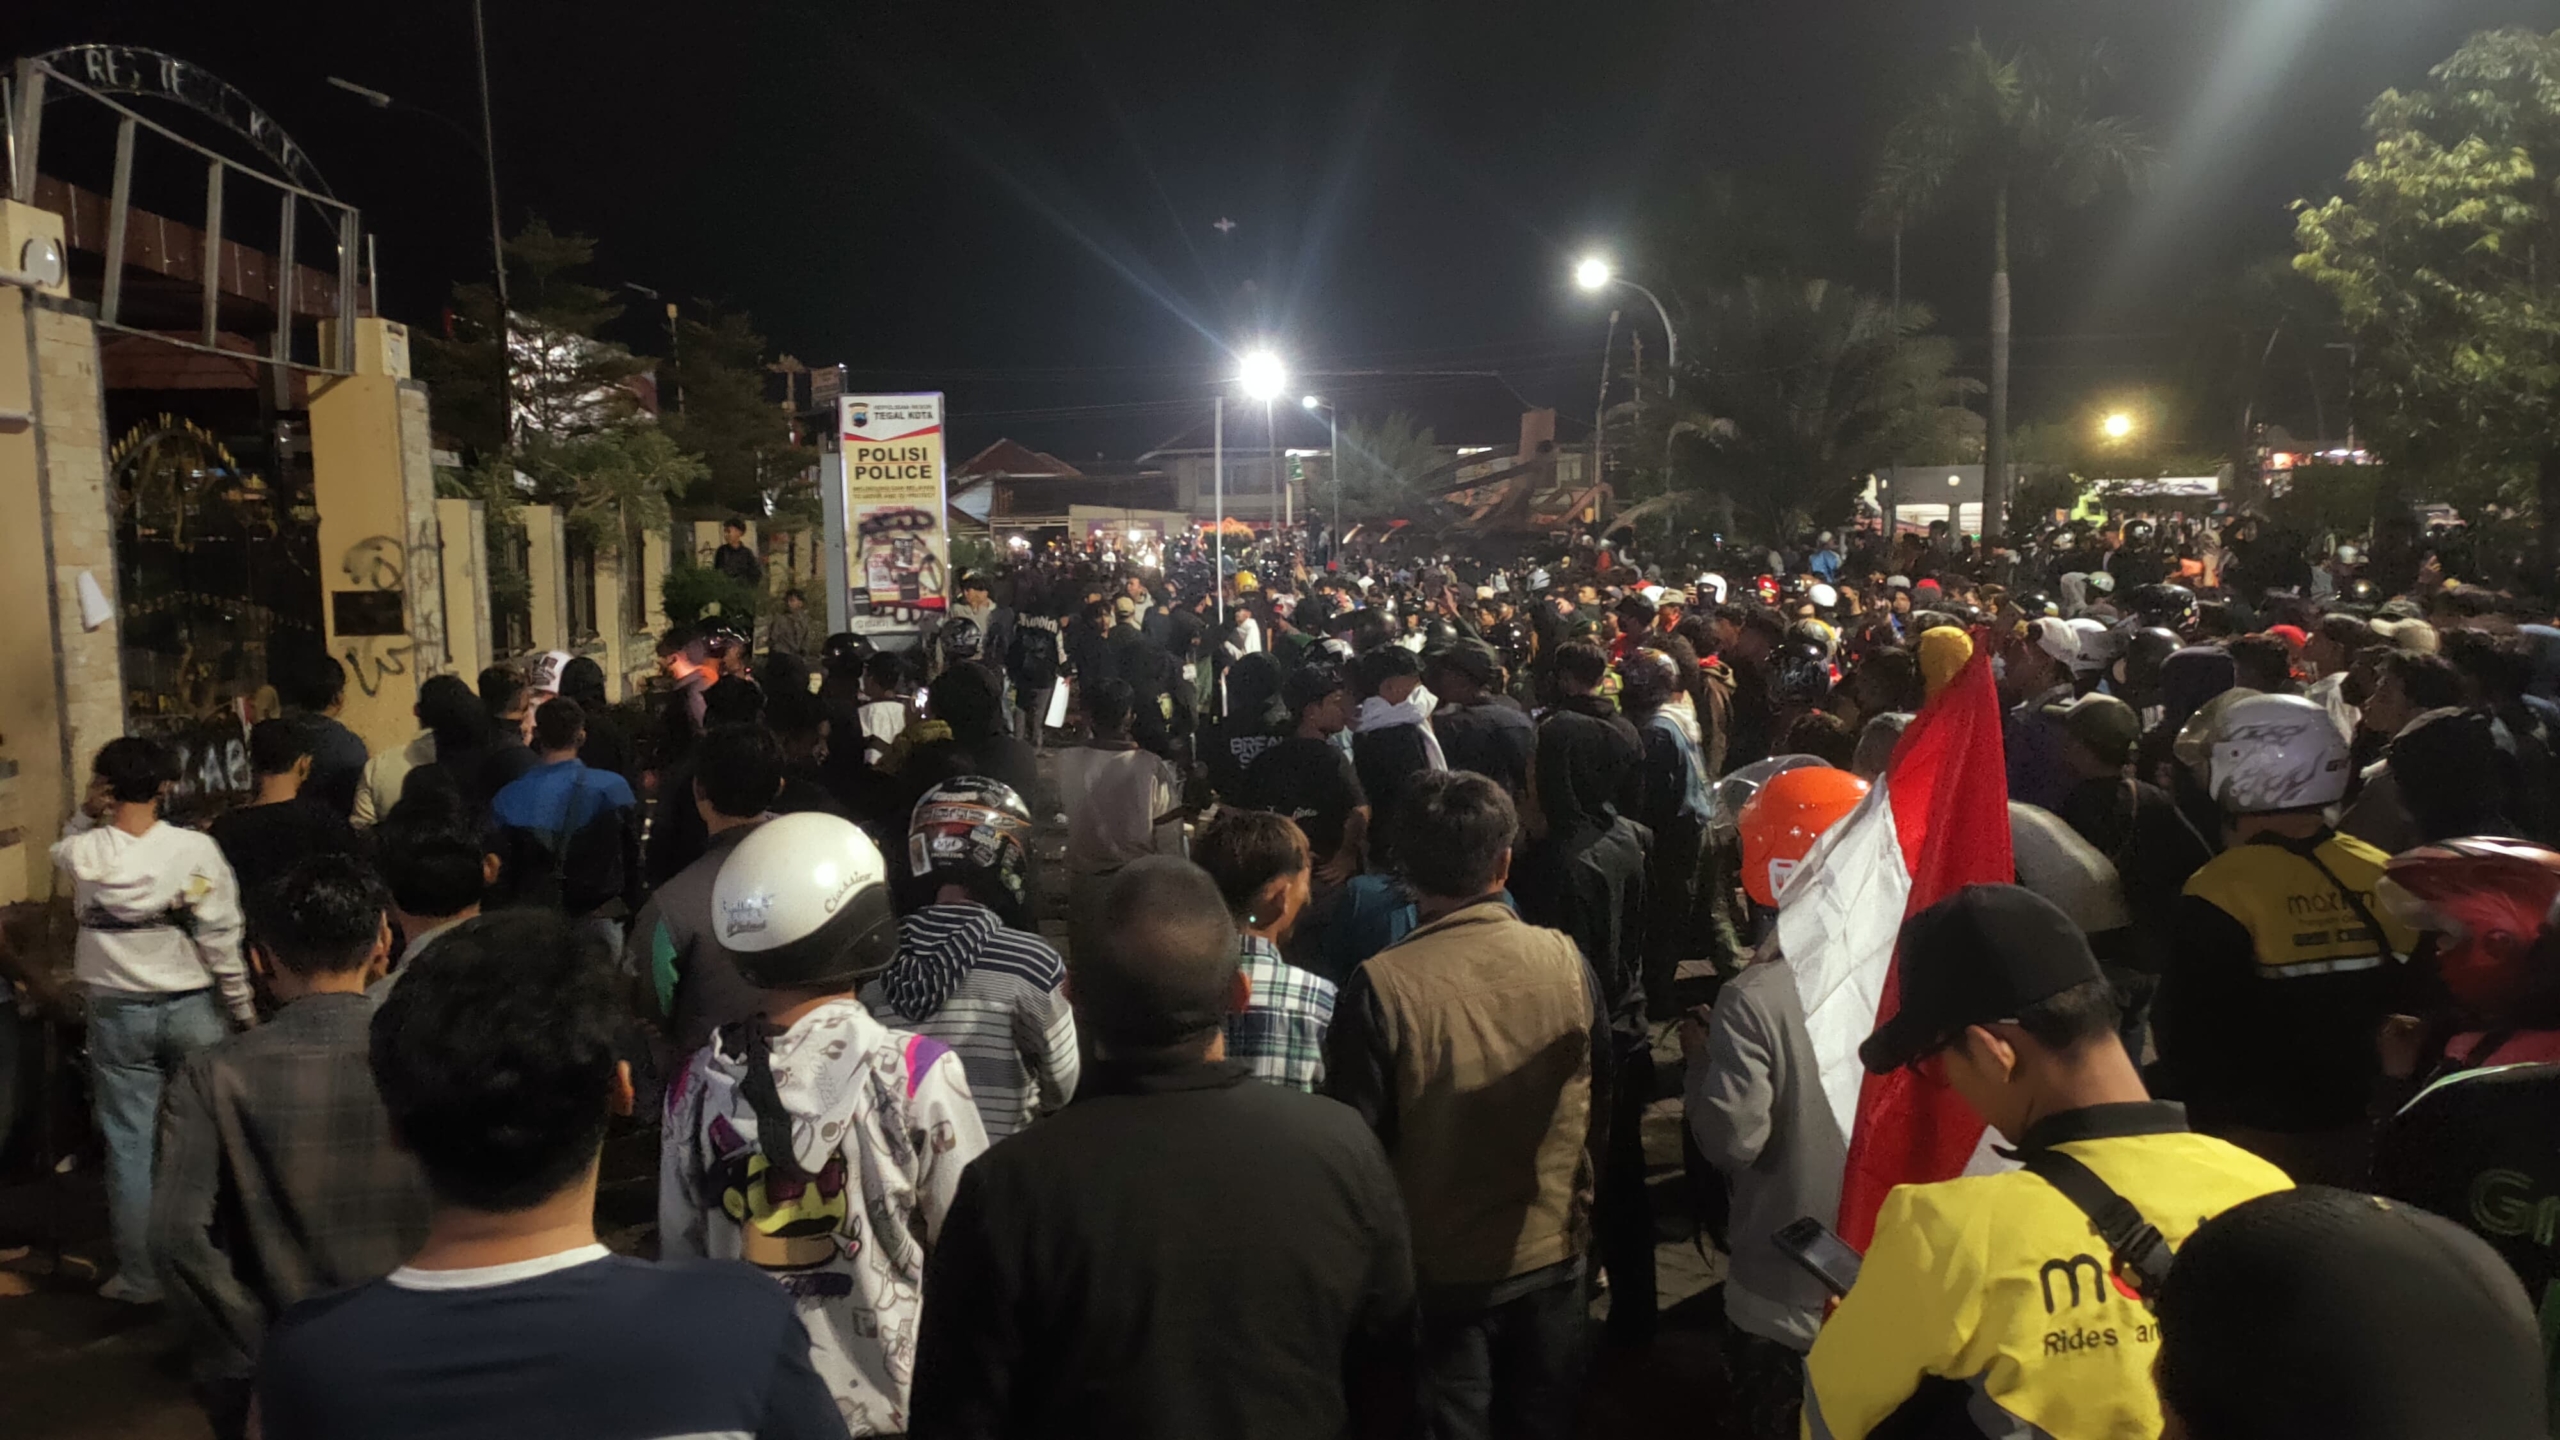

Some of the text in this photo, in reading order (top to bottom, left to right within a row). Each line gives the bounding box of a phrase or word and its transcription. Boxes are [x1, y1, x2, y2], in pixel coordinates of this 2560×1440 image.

[874, 411, 933, 420] TEGAL KOTA
[858, 447, 927, 462] POLISI
[855, 464, 932, 480] POLICE
[2043, 1326, 2118, 1356] Rides
